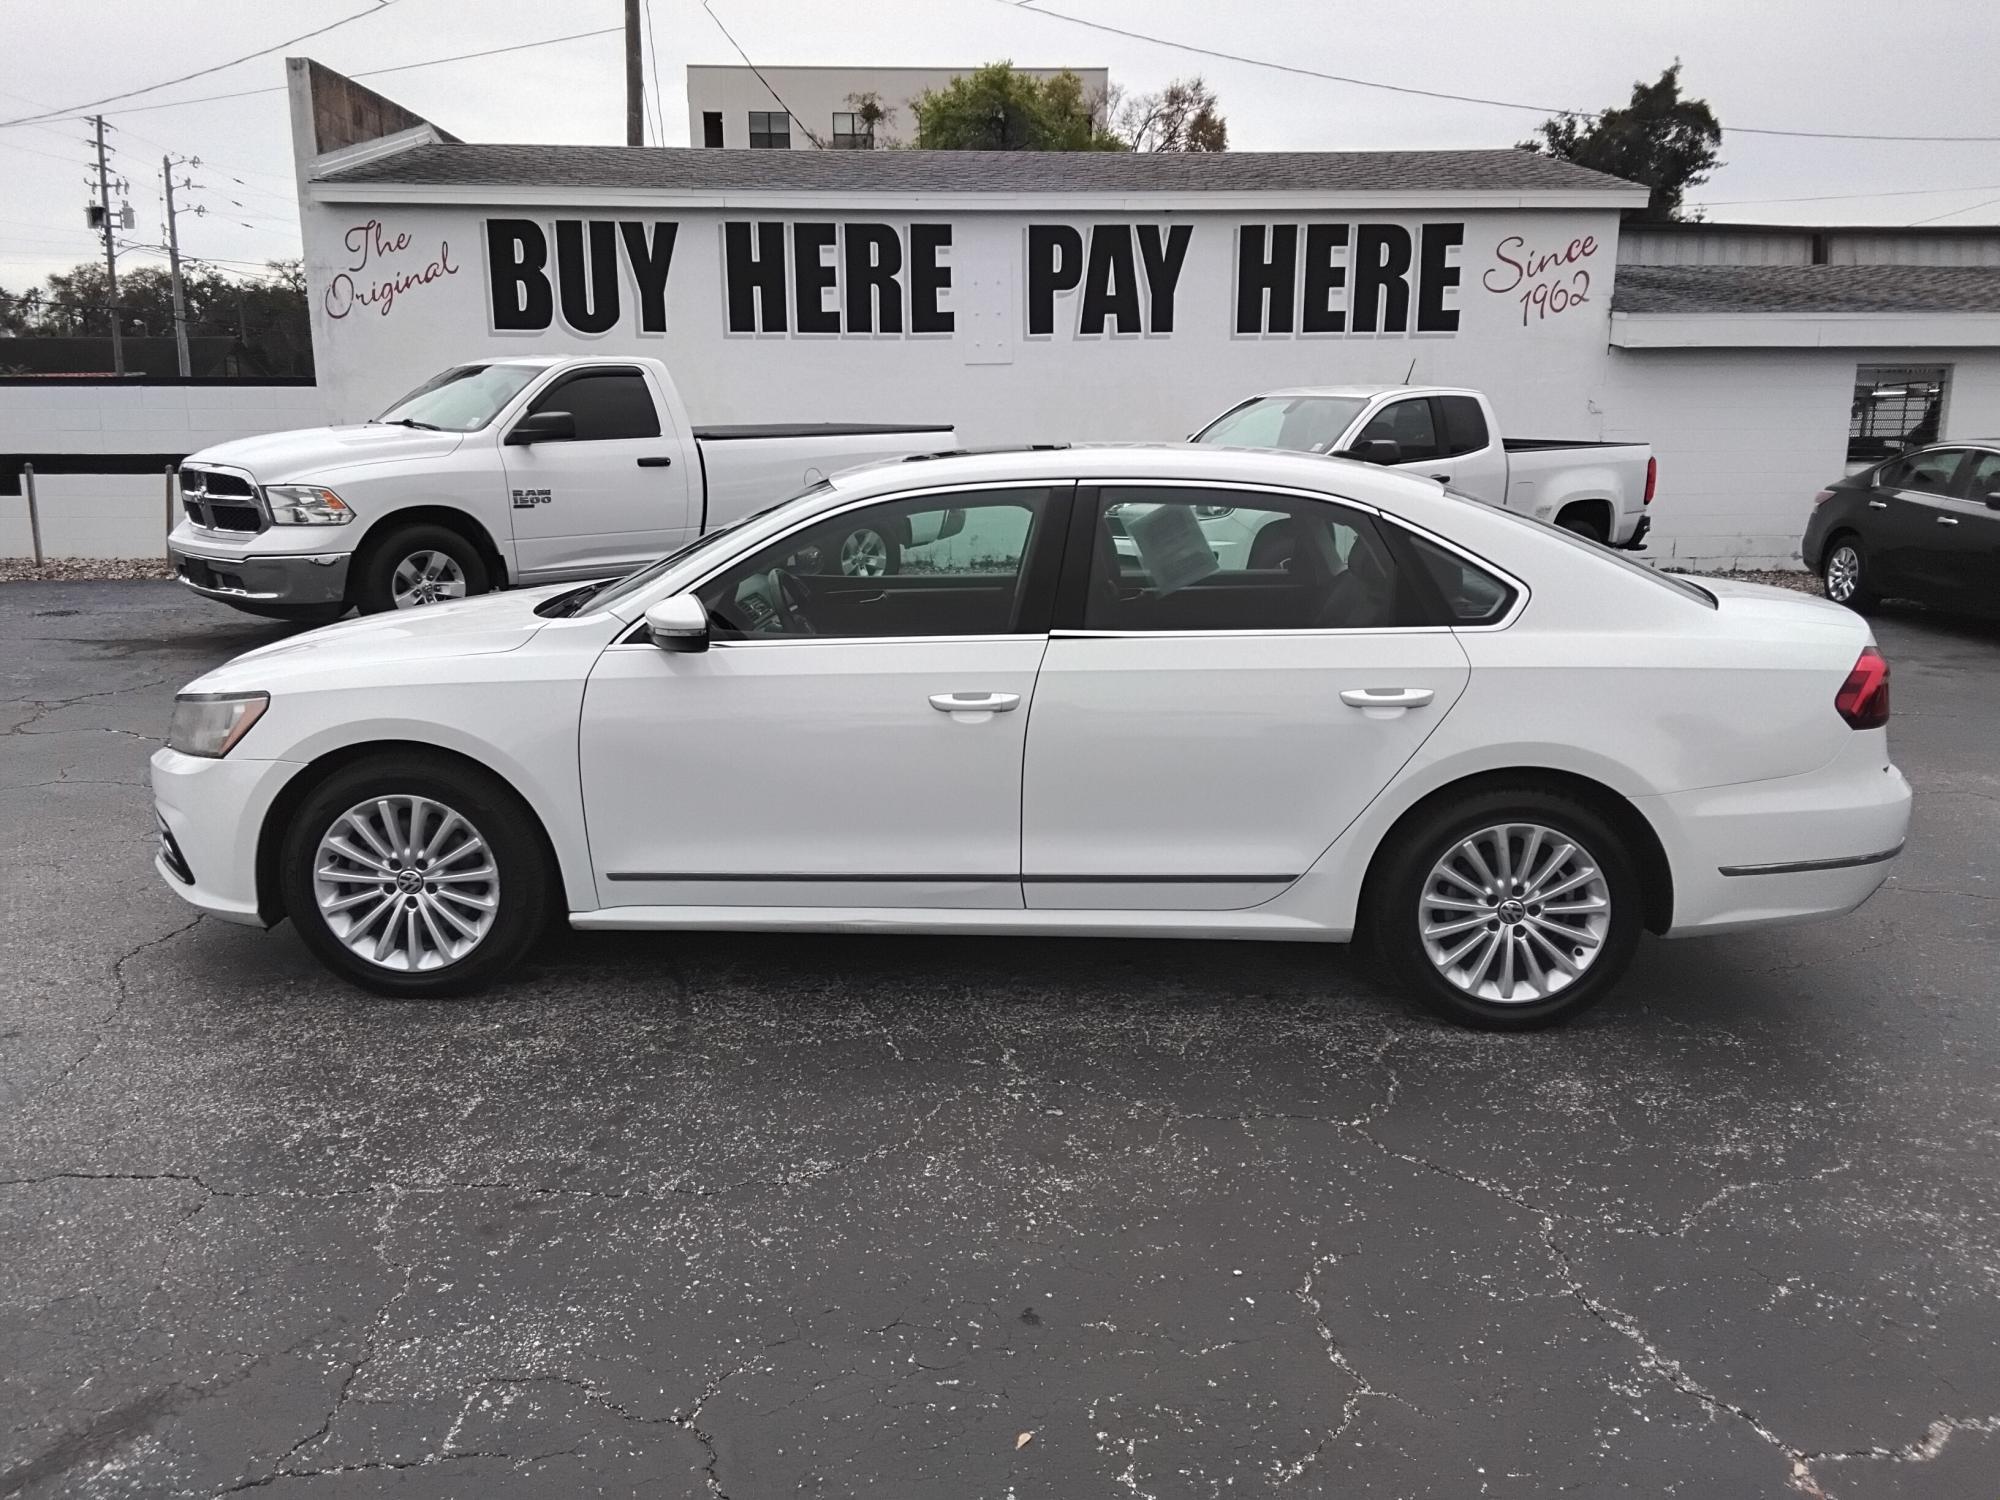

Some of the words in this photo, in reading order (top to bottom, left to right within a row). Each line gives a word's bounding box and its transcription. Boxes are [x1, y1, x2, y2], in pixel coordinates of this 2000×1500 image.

[345, 219, 412, 272] The
[1483, 235, 1599, 293] Since
[325, 240, 459, 319] Original
[484, 219, 679, 334] BUY
[723, 221, 955, 334] HERE
[1027, 224, 1194, 335] PAY
[1235, 222, 1465, 334] HERE
[1520, 270, 1590, 327] 1962
[512, 489, 552, 497] RAM
